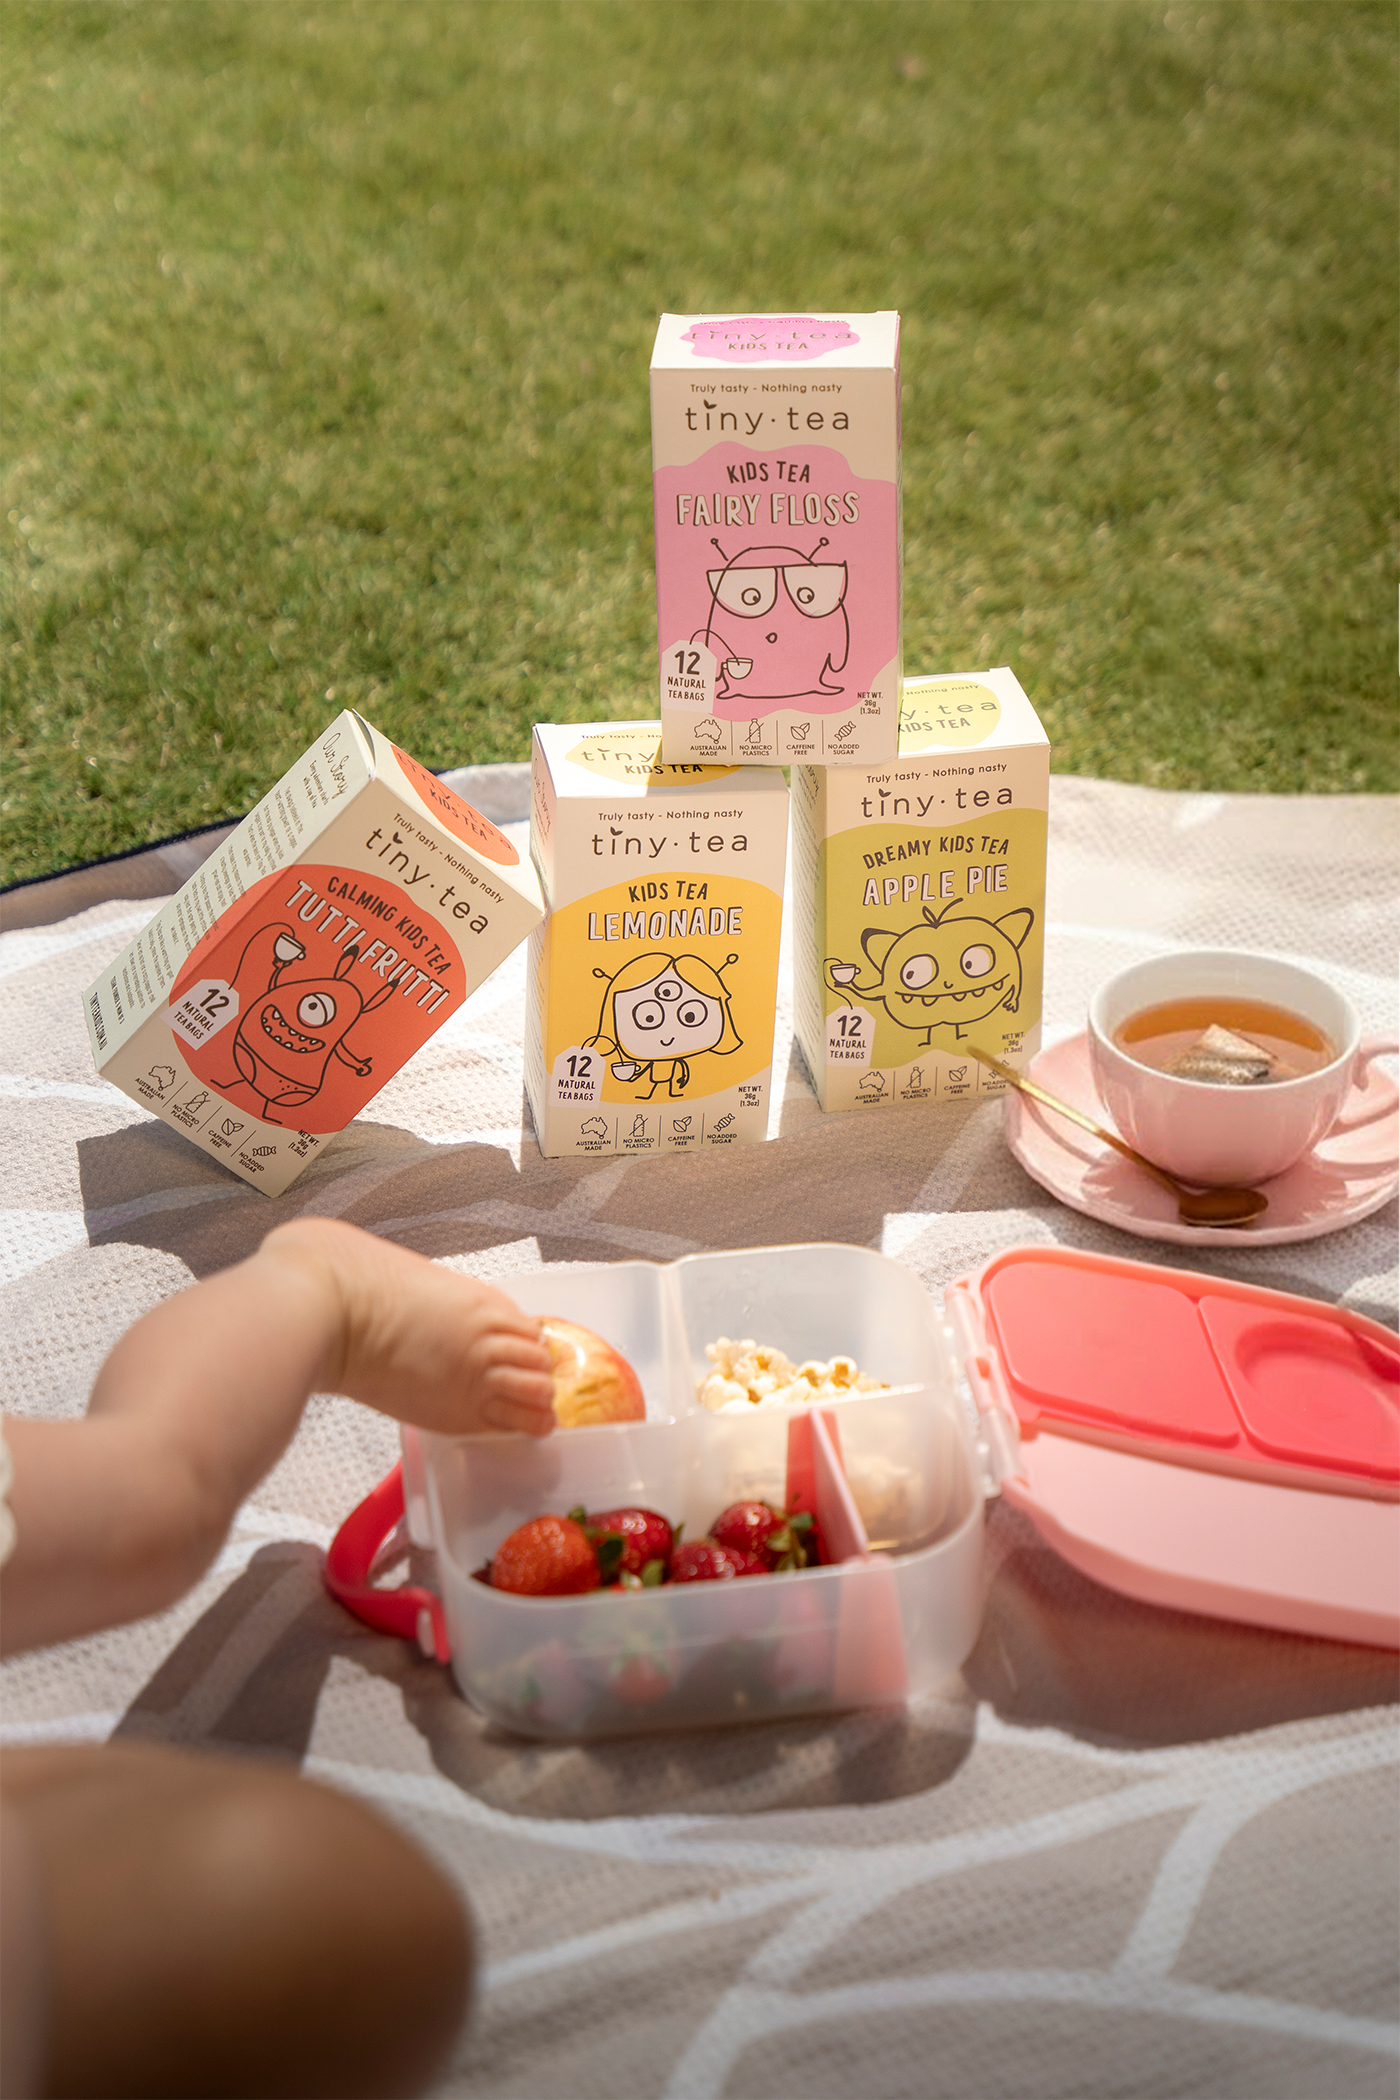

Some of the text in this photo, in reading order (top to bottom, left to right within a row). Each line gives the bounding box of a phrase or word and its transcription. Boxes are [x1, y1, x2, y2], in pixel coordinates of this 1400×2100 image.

[690, 384, 716, 393] Truly
[721, 384, 749, 393] tasty
[761, 383, 807, 394] Nothing
[812, 383, 842, 393] nasty
[727, 461, 811, 483] KIDS TEA
[677, 491, 860, 526] FAIRY FLOSS
[674, 650, 701, 675] 12
[667, 676, 706, 689] NATURAL
[864, 700, 877, 708] 36g
[936, 717, 971, 728] TEA
[323, 733, 349, 799] Our Story
[625, 765, 703, 774] KIDS TEA
[867, 775, 891, 784] Truly
[895, 772, 921, 782] tasty
[932, 766, 975, 777] Nothing
[978, 763, 1008, 773] nasty
[430, 788, 488, 840] KIDS TEA
[599, 812, 623, 821] Truly
[627, 812, 654, 821] tasty
[666, 810, 710, 820] Nothing
[714, 809, 743, 819] nasty
[393, 813, 415, 833] Truly
[415, 831, 438, 851] tasty
[444, 854, 479, 885] Nothing
[479, 883, 504, 904] nasty
[862, 835, 1010, 870] DREAMY KIDS TEA
[629, 880, 708, 903] KIDS TEA
[863, 864, 1009, 906] APPLE PIE
[327, 876, 452, 976] CALMING KIDS TEA
[588, 907, 744, 941] LEMONADE
[285, 880, 367, 952] TUTTI
[358, 938, 450, 1015] FRUTTI
[200, 989, 230, 1018] 12
[182, 1001, 214, 1031] NATURAL
[837, 1015, 863, 1037] 12
[829, 1039, 866, 1049] NATURAL
[566, 1055, 592, 1077] 12
[135, 1078, 165, 1100] AUSTRALIAN
[138, 1087, 155, 1099] MADE
[558, 1079, 596, 1090] NATURAL
[855, 1092, 889, 1101] AUSTRALIAN
[170, 1110, 194, 1128] PLASTICS
[172, 1104, 200, 1125] NO MICRO
[208, 1130, 232, 1148] CAFFEINE
[209, 1139, 222, 1148] FREE
[238, 1159, 257, 1173] SUGAR
[239, 1152, 265, 1171] NO ADDED
